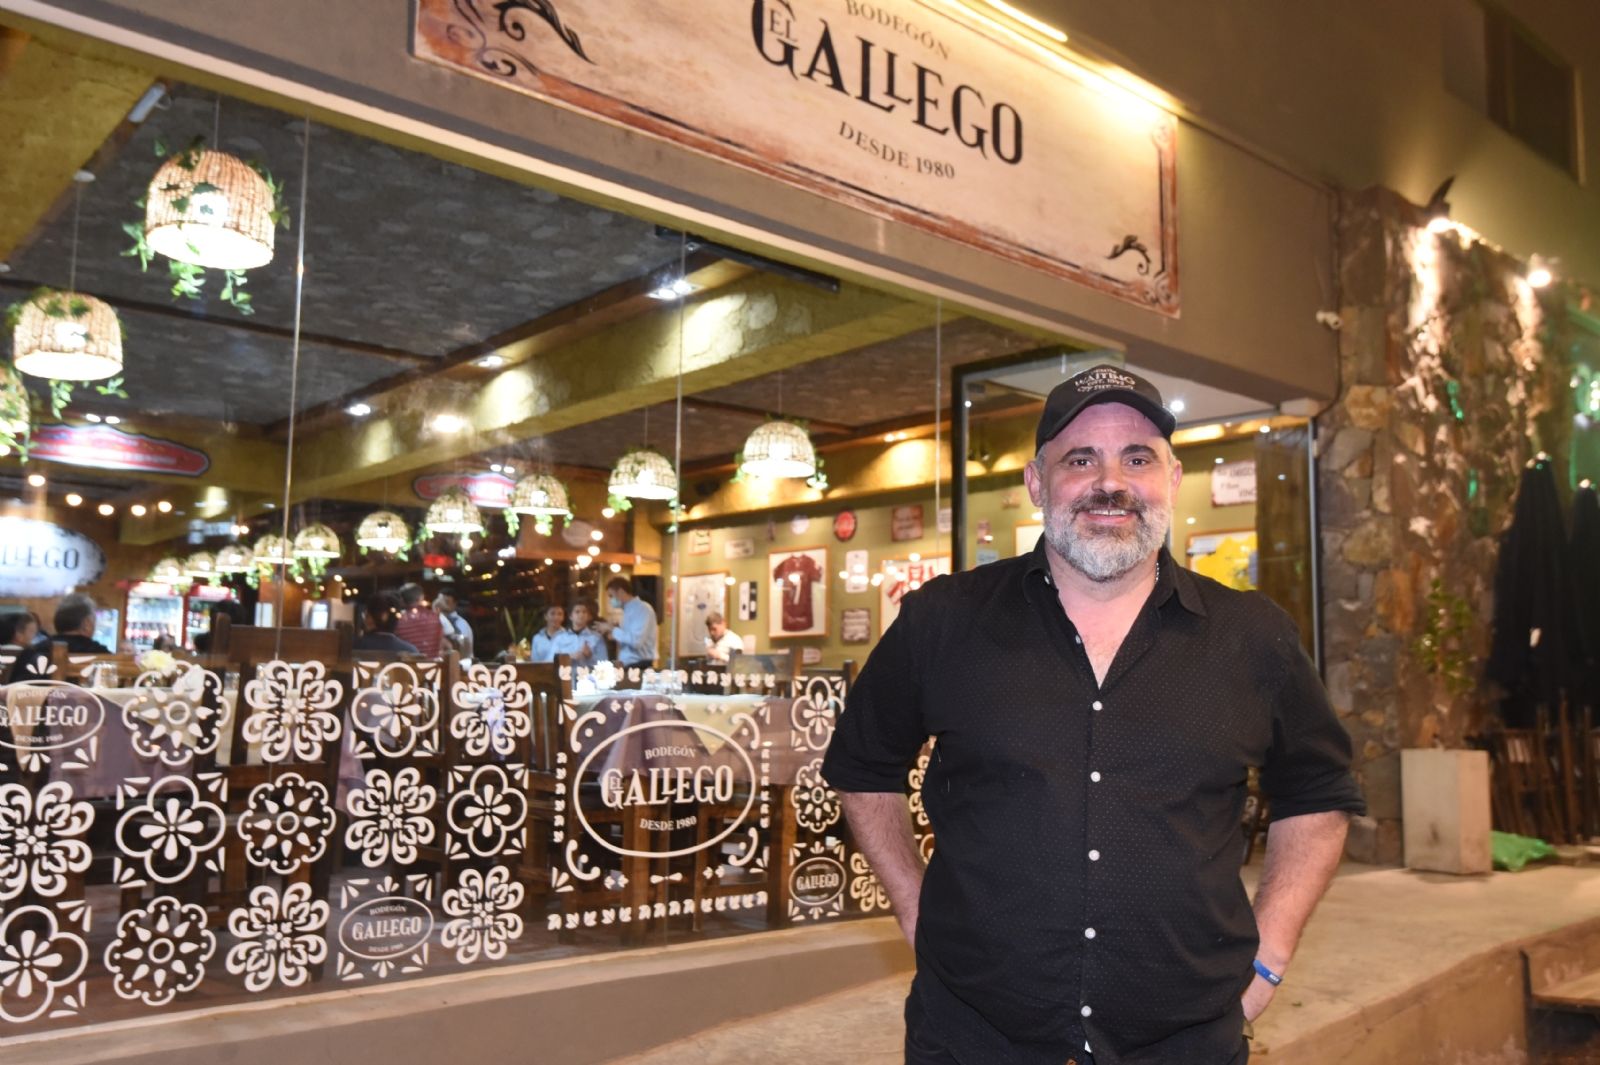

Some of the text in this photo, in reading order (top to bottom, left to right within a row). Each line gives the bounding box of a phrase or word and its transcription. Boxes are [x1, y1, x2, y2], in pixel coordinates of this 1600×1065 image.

[846, 0, 949, 60] BODEGÓN
[752, 0, 1022, 165] EL GALLEGO
[839, 121, 955, 179] DESDE 1980
[645, 745, 696, 760] BODEGÓN
[601, 765, 733, 809] GALLEGO
[640, 815, 697, 831] DESDE 1980
[352, 916, 422, 941] GALLEGO
